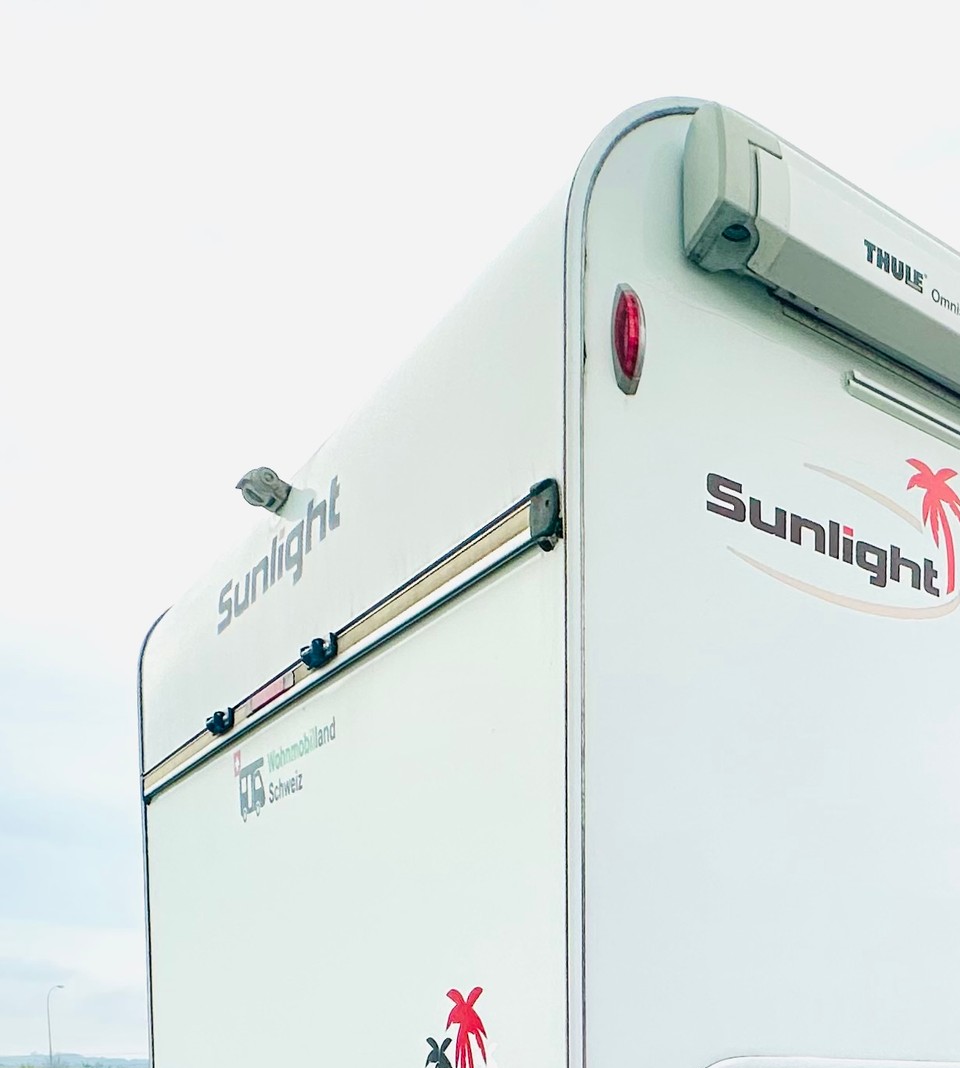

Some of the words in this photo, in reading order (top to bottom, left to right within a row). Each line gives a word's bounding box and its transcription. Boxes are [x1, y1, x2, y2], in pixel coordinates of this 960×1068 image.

[863, 239, 924, 294] THULE
[217, 475, 341, 635] Sunlight
[706, 472, 940, 597] Sunlight
[266, 716, 336, 773] Wohnmobilland
[268, 769, 303, 803] Schweiz
